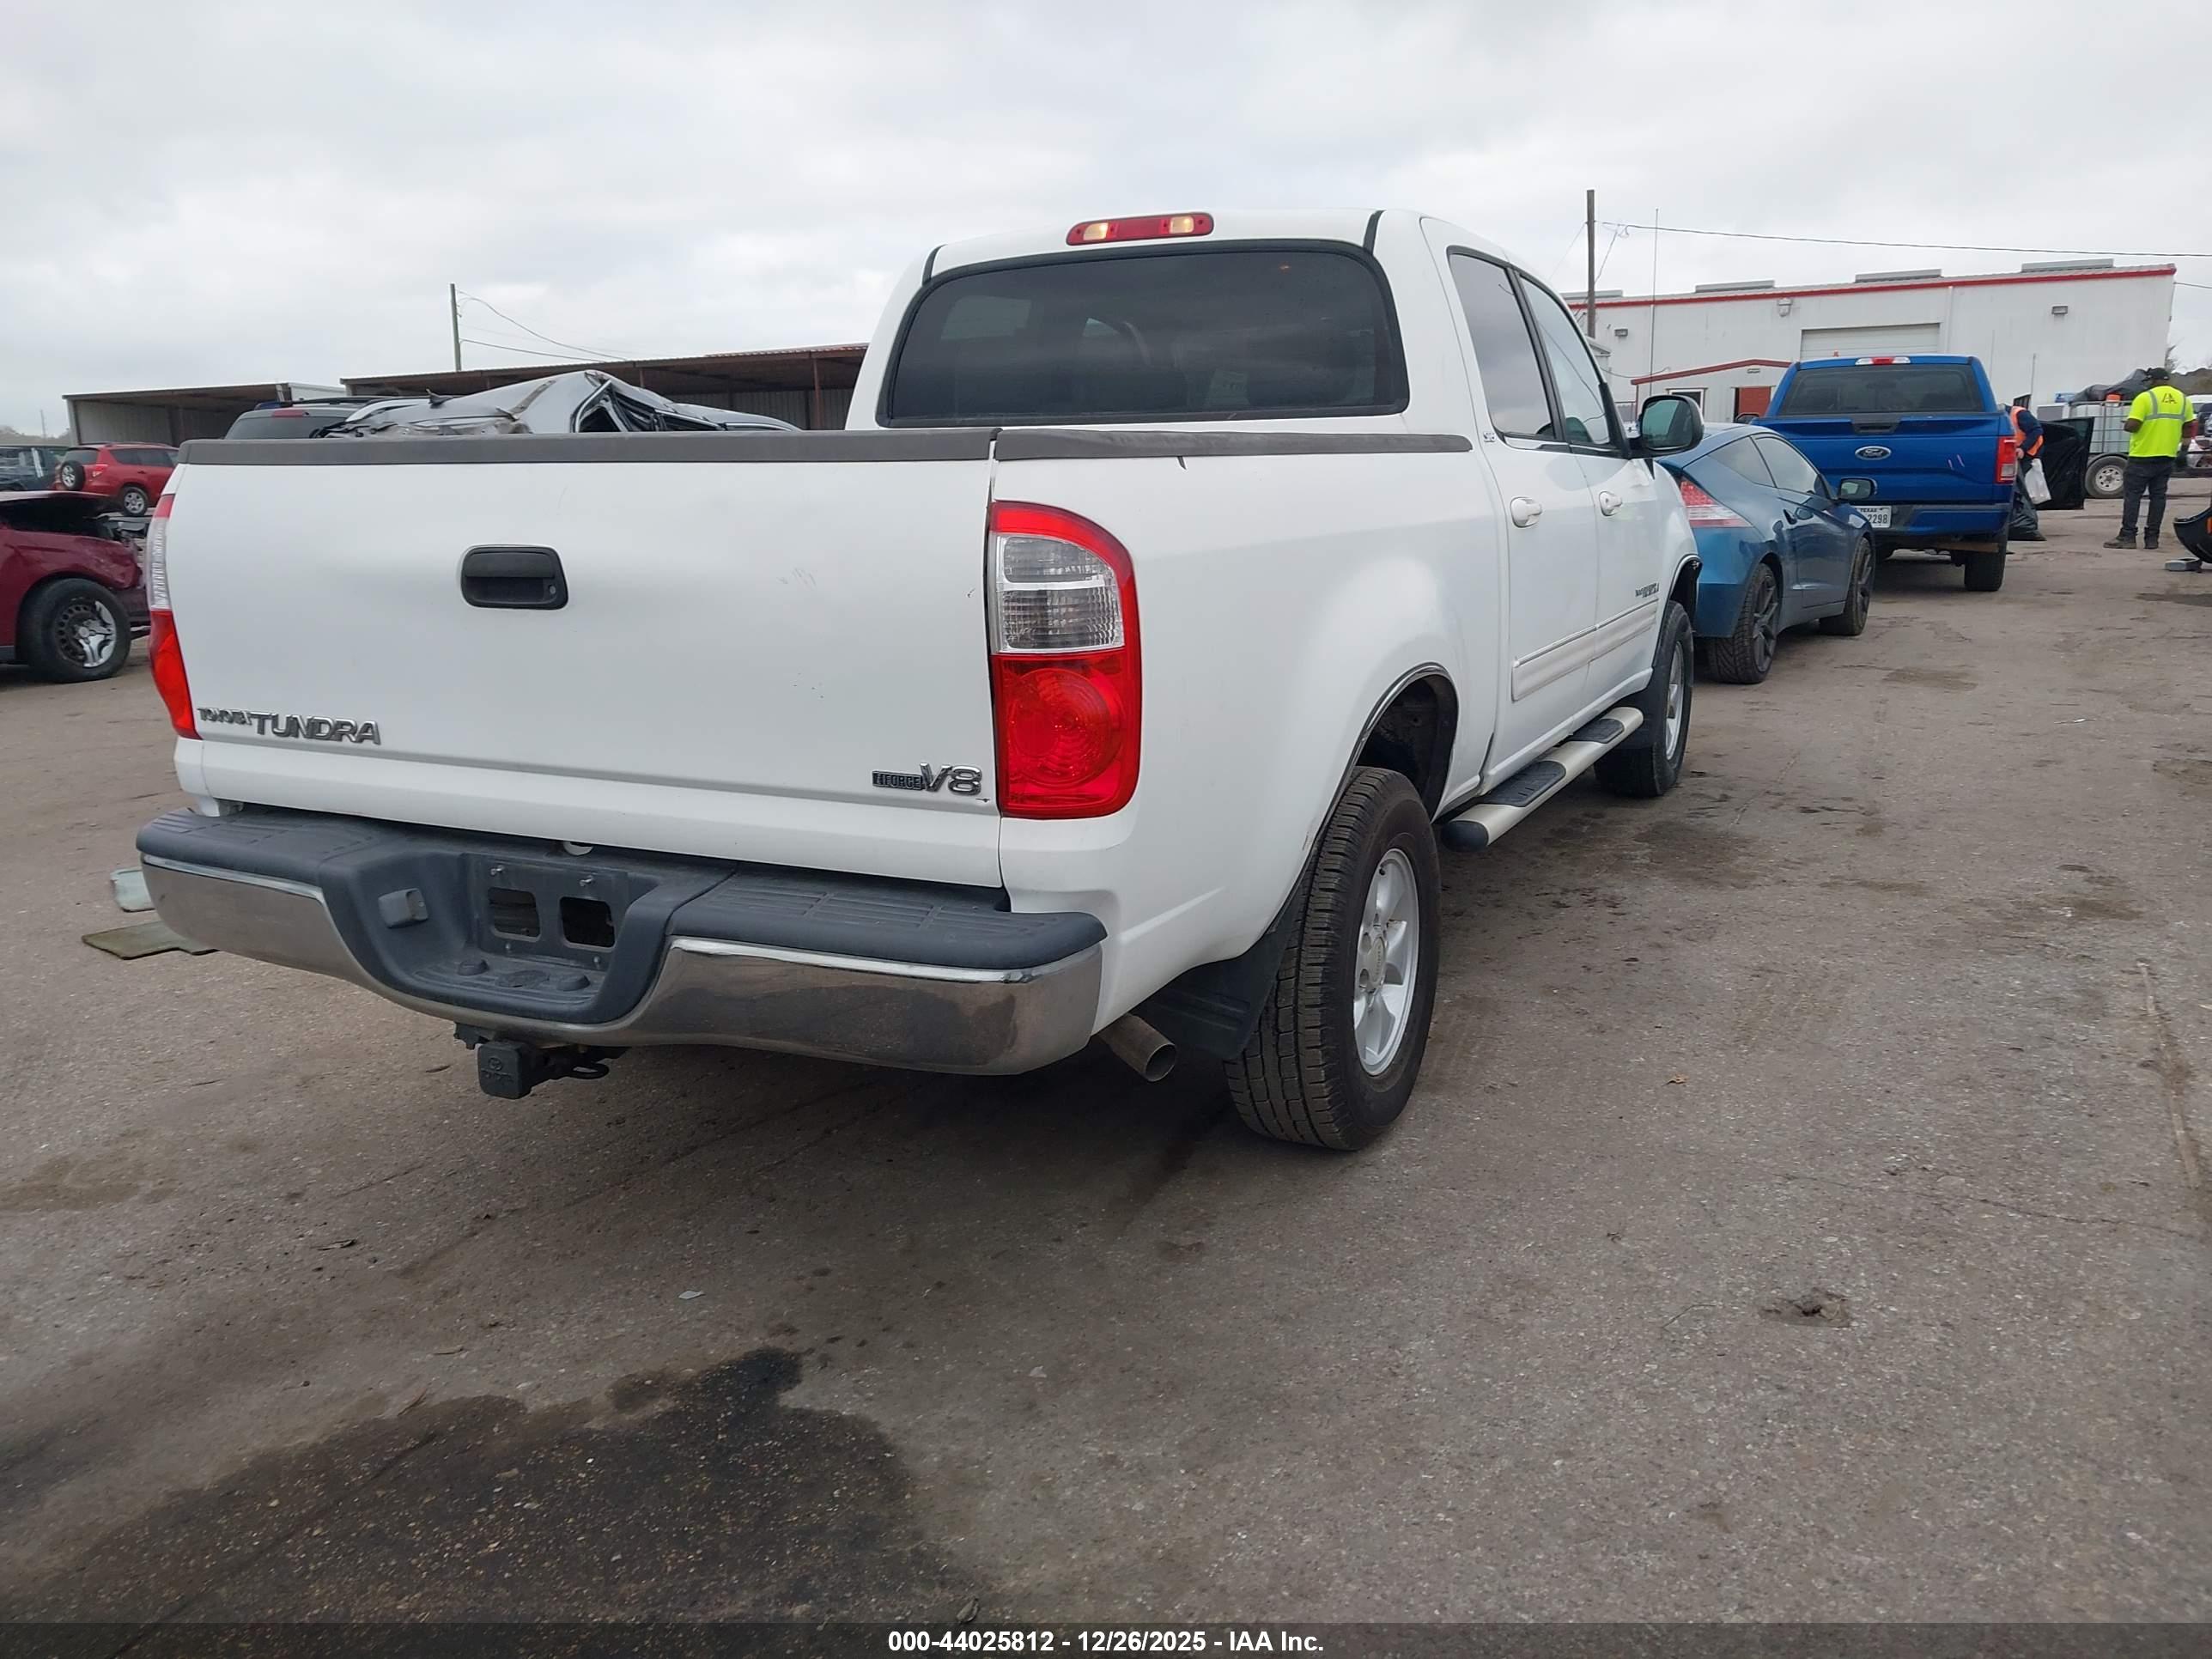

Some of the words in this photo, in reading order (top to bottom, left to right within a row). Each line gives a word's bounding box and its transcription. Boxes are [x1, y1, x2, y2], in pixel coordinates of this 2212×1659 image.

[198, 708, 252, 726] TOYOTA
[249, 711, 382, 744] TUNDRA
[921, 763, 982, 796] V8
